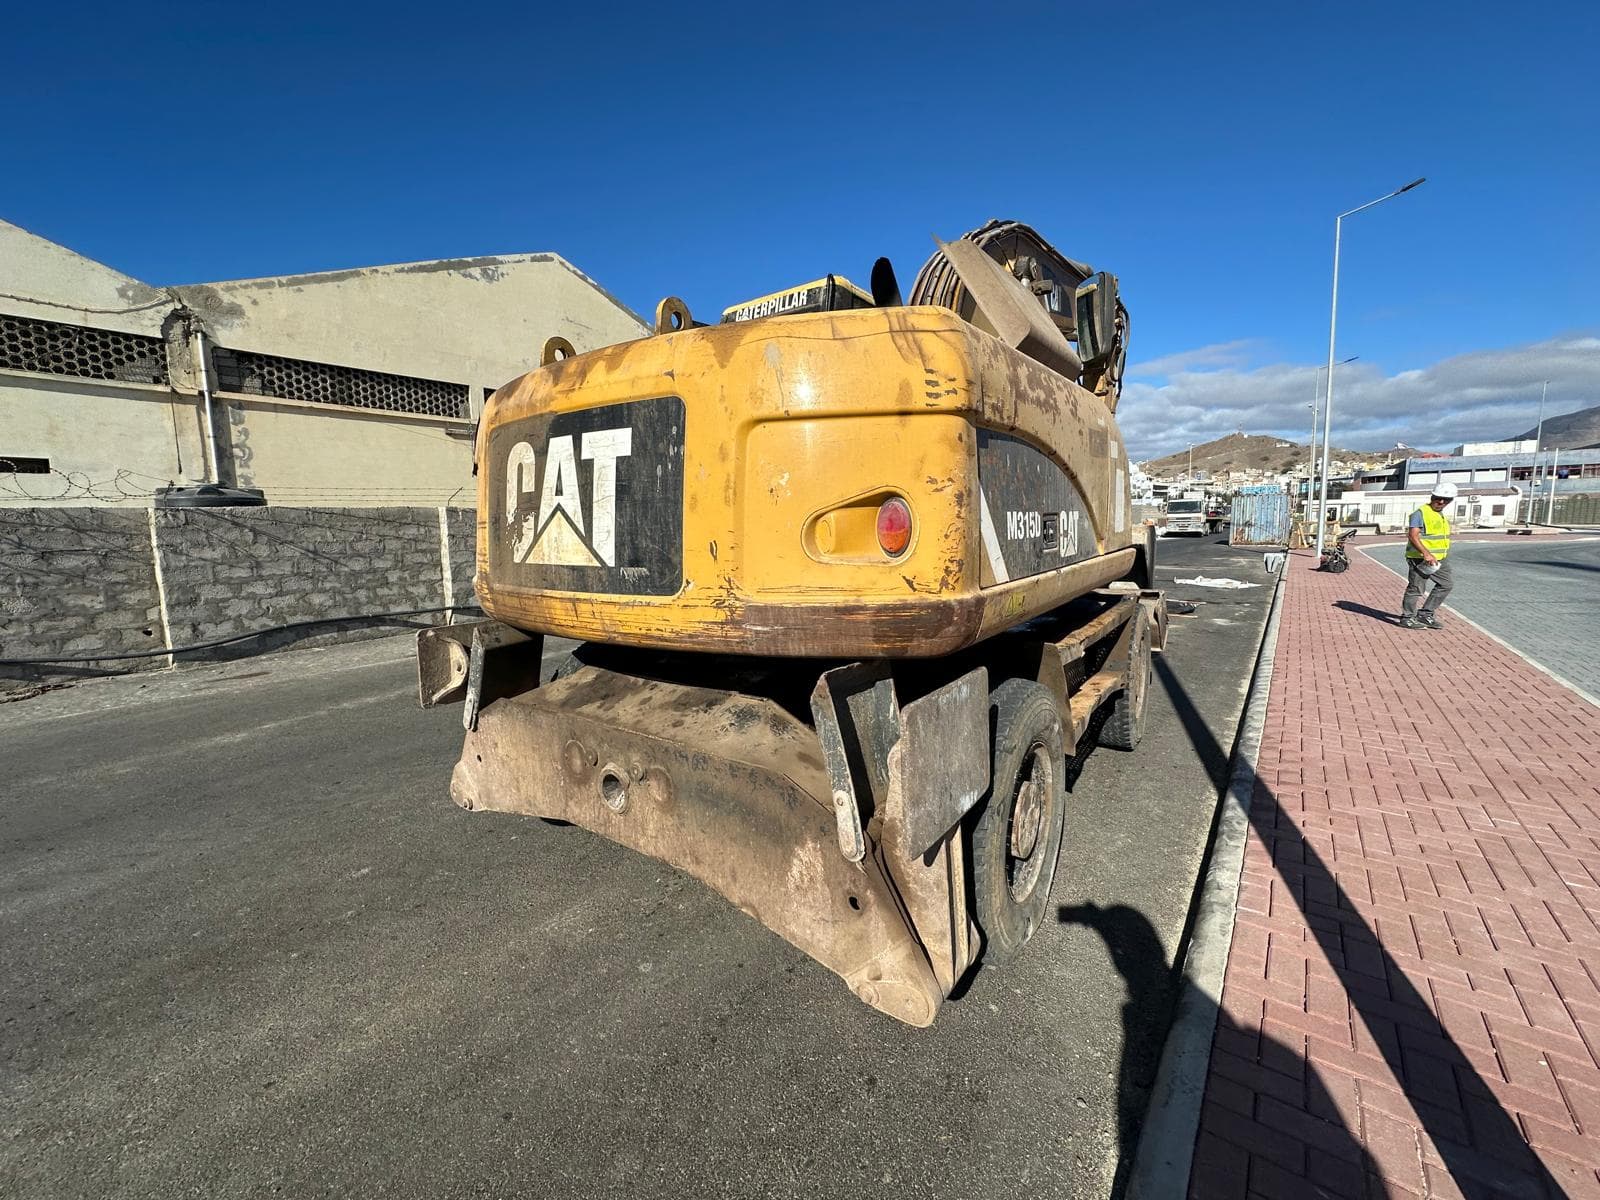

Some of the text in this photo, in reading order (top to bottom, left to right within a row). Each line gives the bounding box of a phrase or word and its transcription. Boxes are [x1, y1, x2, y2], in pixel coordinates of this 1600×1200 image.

[735, 290, 808, 322] CATERPILLAR
[506, 427, 632, 567] CAT
[1007, 511, 1041, 540] M315D
[1059, 510, 1079, 557] CAT
